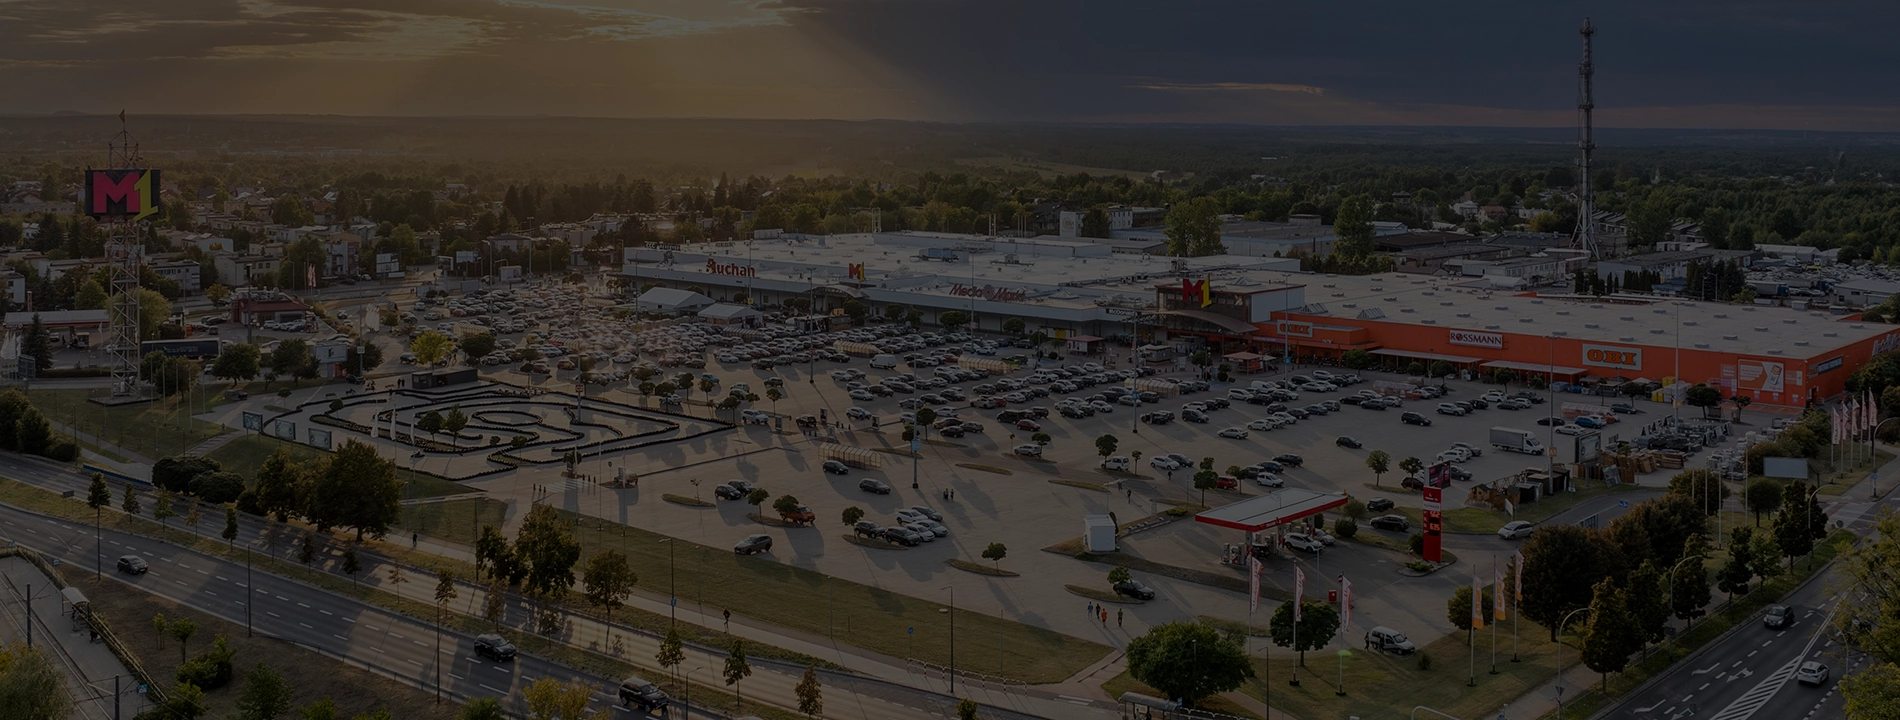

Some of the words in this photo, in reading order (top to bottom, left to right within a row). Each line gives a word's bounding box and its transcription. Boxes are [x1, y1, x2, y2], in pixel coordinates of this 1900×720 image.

[93, 167, 158, 222] M1
[706, 258, 755, 278] Auchan
[848, 261, 866, 282] M1
[949, 283, 983, 298] Media
[994, 287, 1026, 302] Markt
[1182, 273, 1213, 309] M1
[1450, 332, 1502, 345] ROSSMANN
[1587, 349, 1637, 366] OBI
